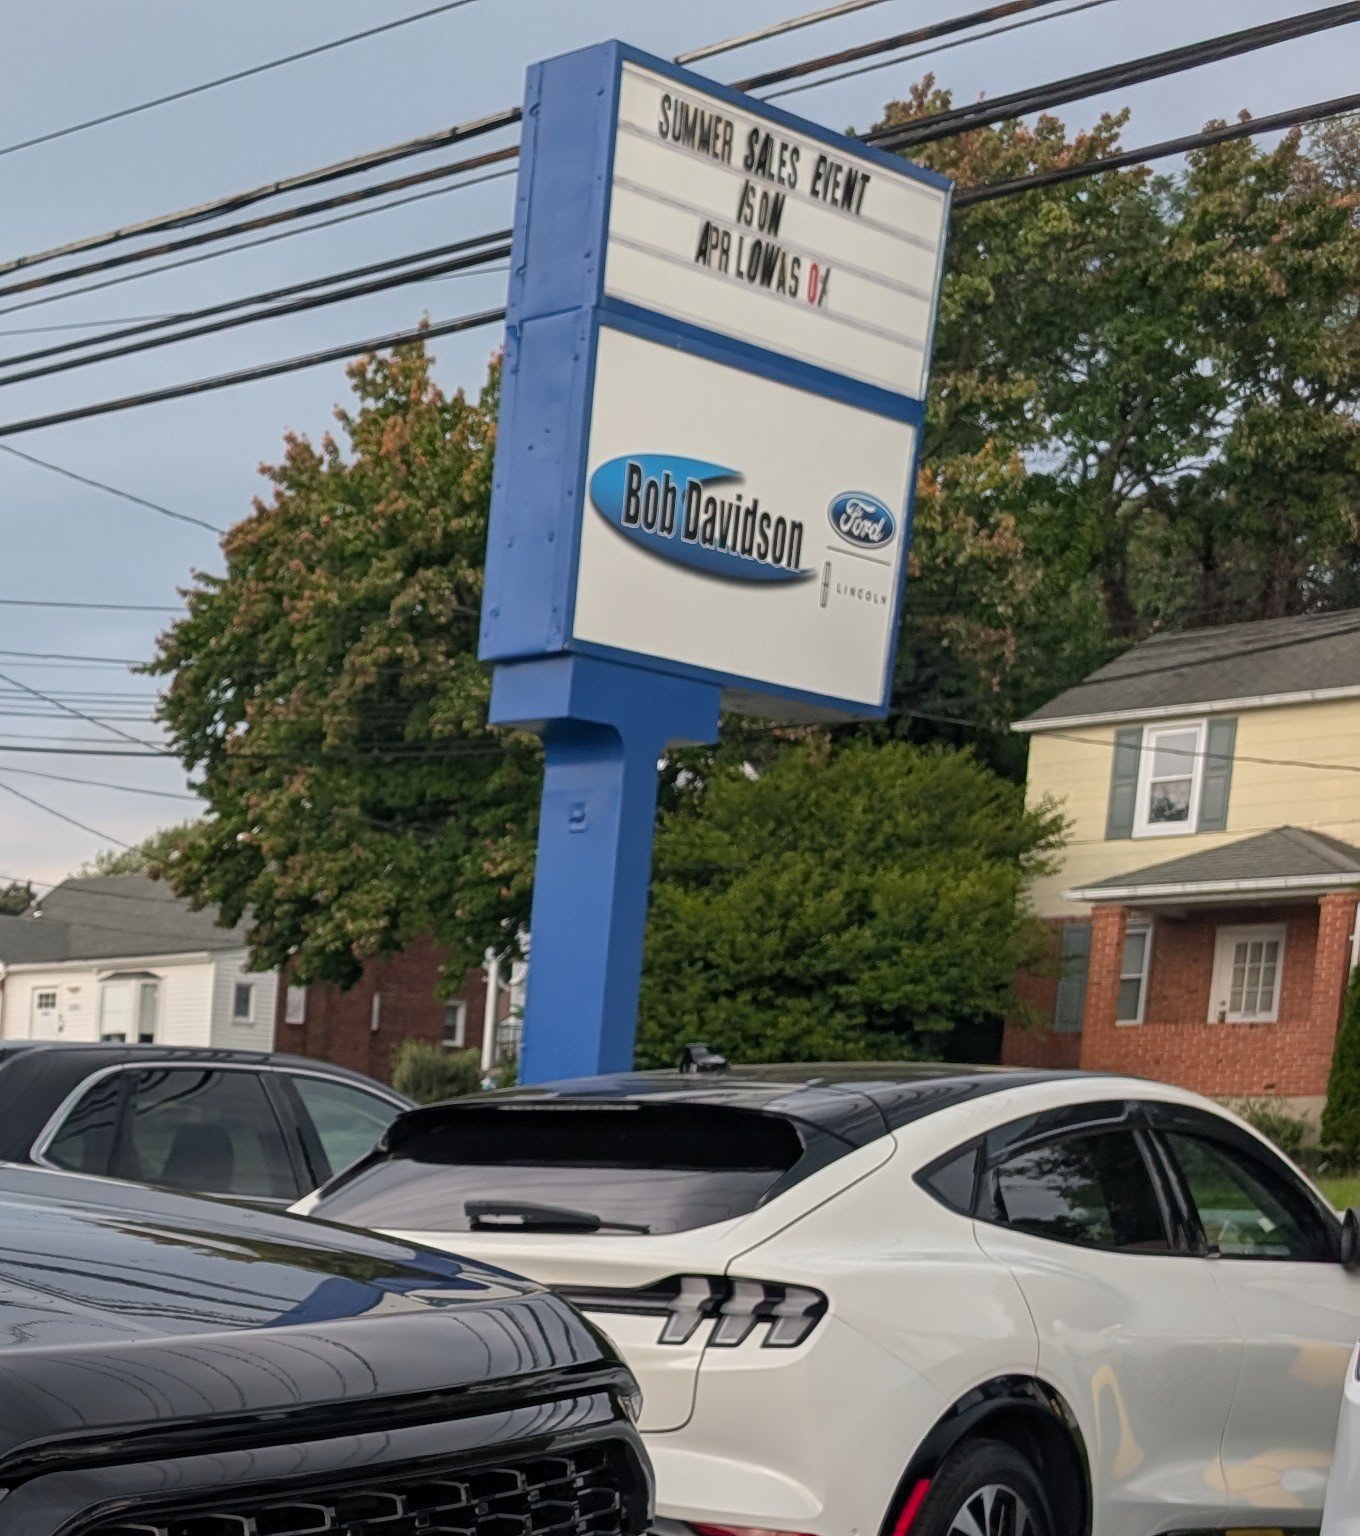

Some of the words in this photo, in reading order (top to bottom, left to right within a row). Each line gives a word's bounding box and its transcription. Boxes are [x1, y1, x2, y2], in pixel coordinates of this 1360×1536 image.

[658, 93, 734, 164] SUMMER
[743, 127, 800, 190] SALES
[809, 154, 871, 216] EVENT
[694, 221, 732, 275] APR
[734, 235, 781, 289] LOW
[622, 460, 677, 538] Bob
[682, 477, 805, 572] Davidson
[840, 498, 886, 542] Ford
[835, 582, 889, 606] LINCOLN
